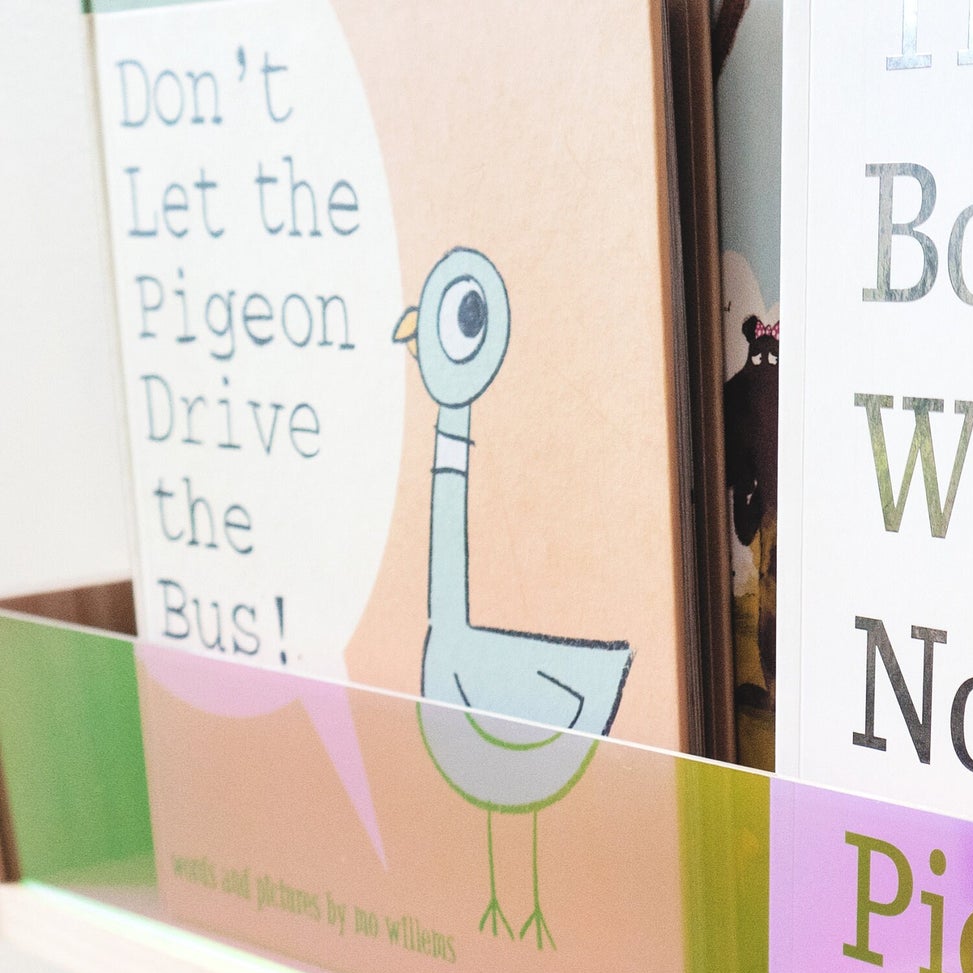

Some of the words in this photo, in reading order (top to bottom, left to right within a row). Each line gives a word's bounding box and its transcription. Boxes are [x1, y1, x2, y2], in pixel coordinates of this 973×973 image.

[115, 46, 294, 129] Don't
[123, 166, 225, 239] Let
[255, 156, 361, 238] the
[134, 267, 356, 361] Pigeon
[140, 373, 322, 459] Drive
[153, 477, 255, 555] the
[157, 577, 289, 665] Bus!
[256, 873, 320, 921] pictures
[326, 891, 345, 938] by
[354, 906, 379, 938] mo
[384, 914, 456, 963] willems
